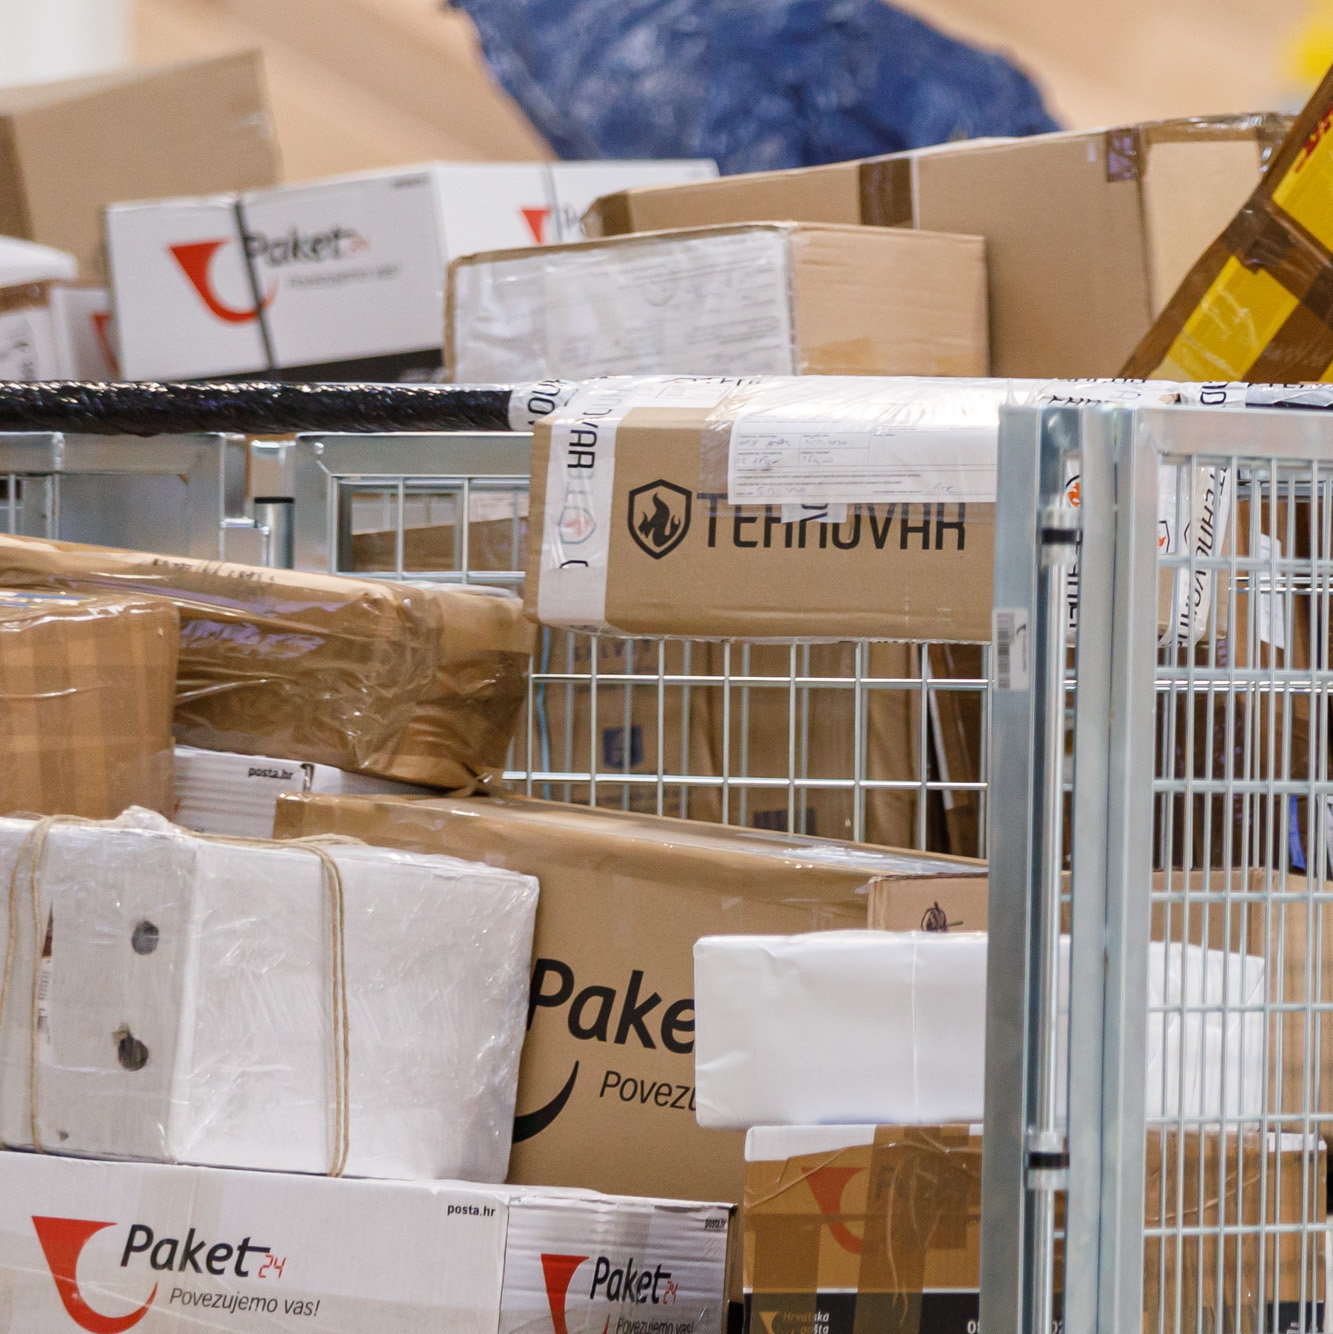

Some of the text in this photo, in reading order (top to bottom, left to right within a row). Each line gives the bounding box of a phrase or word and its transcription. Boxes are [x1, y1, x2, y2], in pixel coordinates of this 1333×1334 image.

[248, 767, 294, 780] posta.hr
[447, 1202, 496, 1218] posta.hr
[703, 1218, 728, 1230] posta.hr
[119, 1222, 288, 1280] Paket 24
[589, 1256, 673, 1305] Paket
[168, 1286, 321, 1318] Povezujemo vas!
[782, 1309, 831, 1324] Hrvatska
